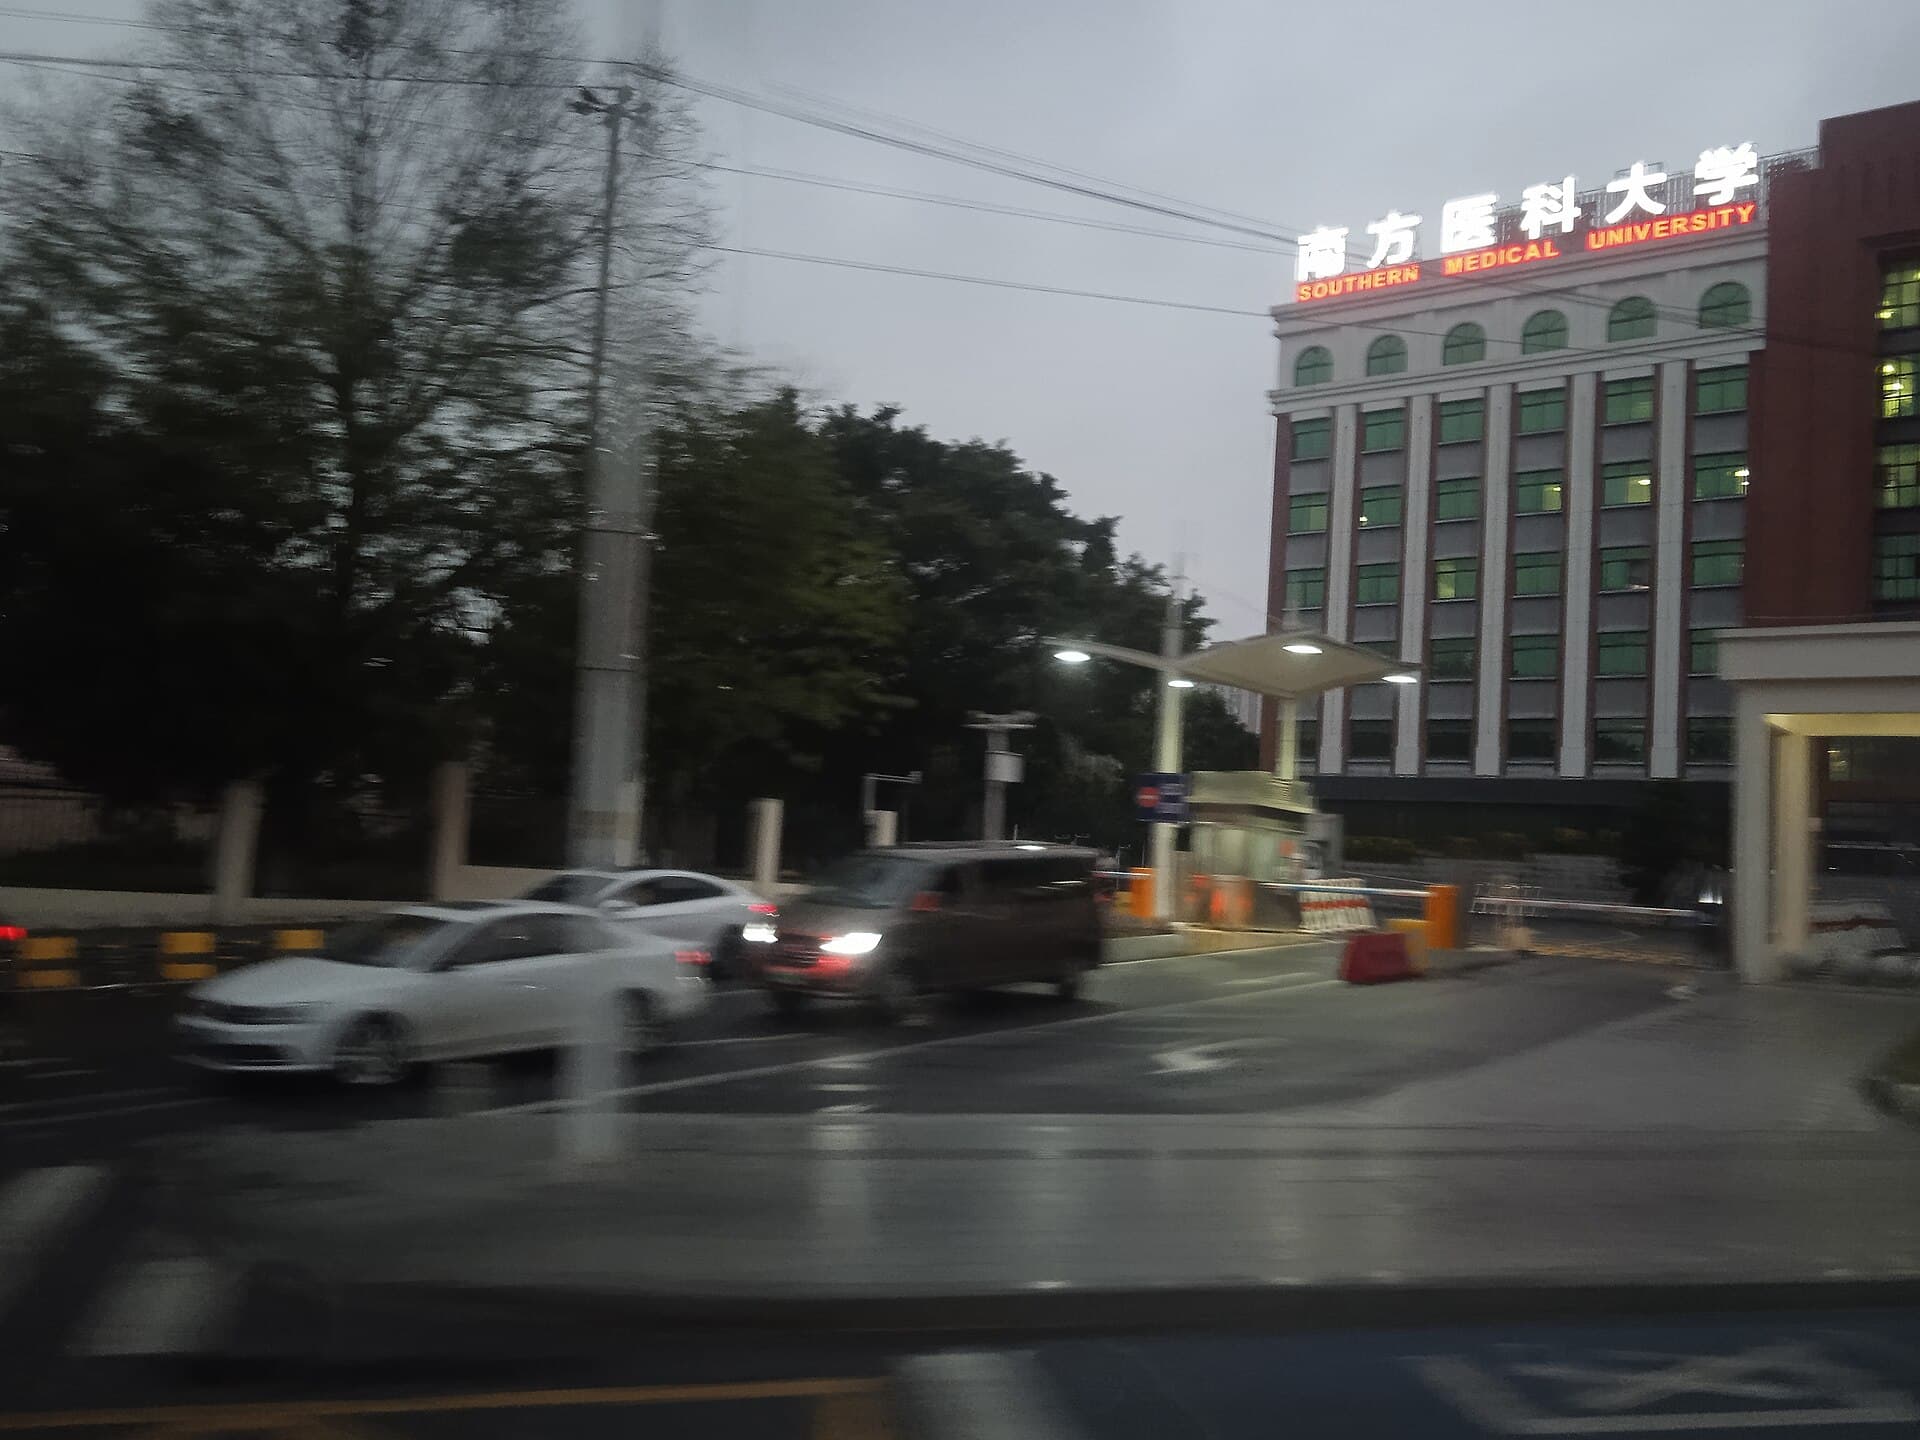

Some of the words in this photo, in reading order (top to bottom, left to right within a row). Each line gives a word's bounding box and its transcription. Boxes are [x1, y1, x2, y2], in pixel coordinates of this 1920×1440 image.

[1295, 142, 1759, 280] 南方医科大学
[1297, 265, 1420, 302] SOUTHERN
[1444, 242, 1559, 275] MEDICAL
[1588, 204, 1756, 250] UNIVERSITY
